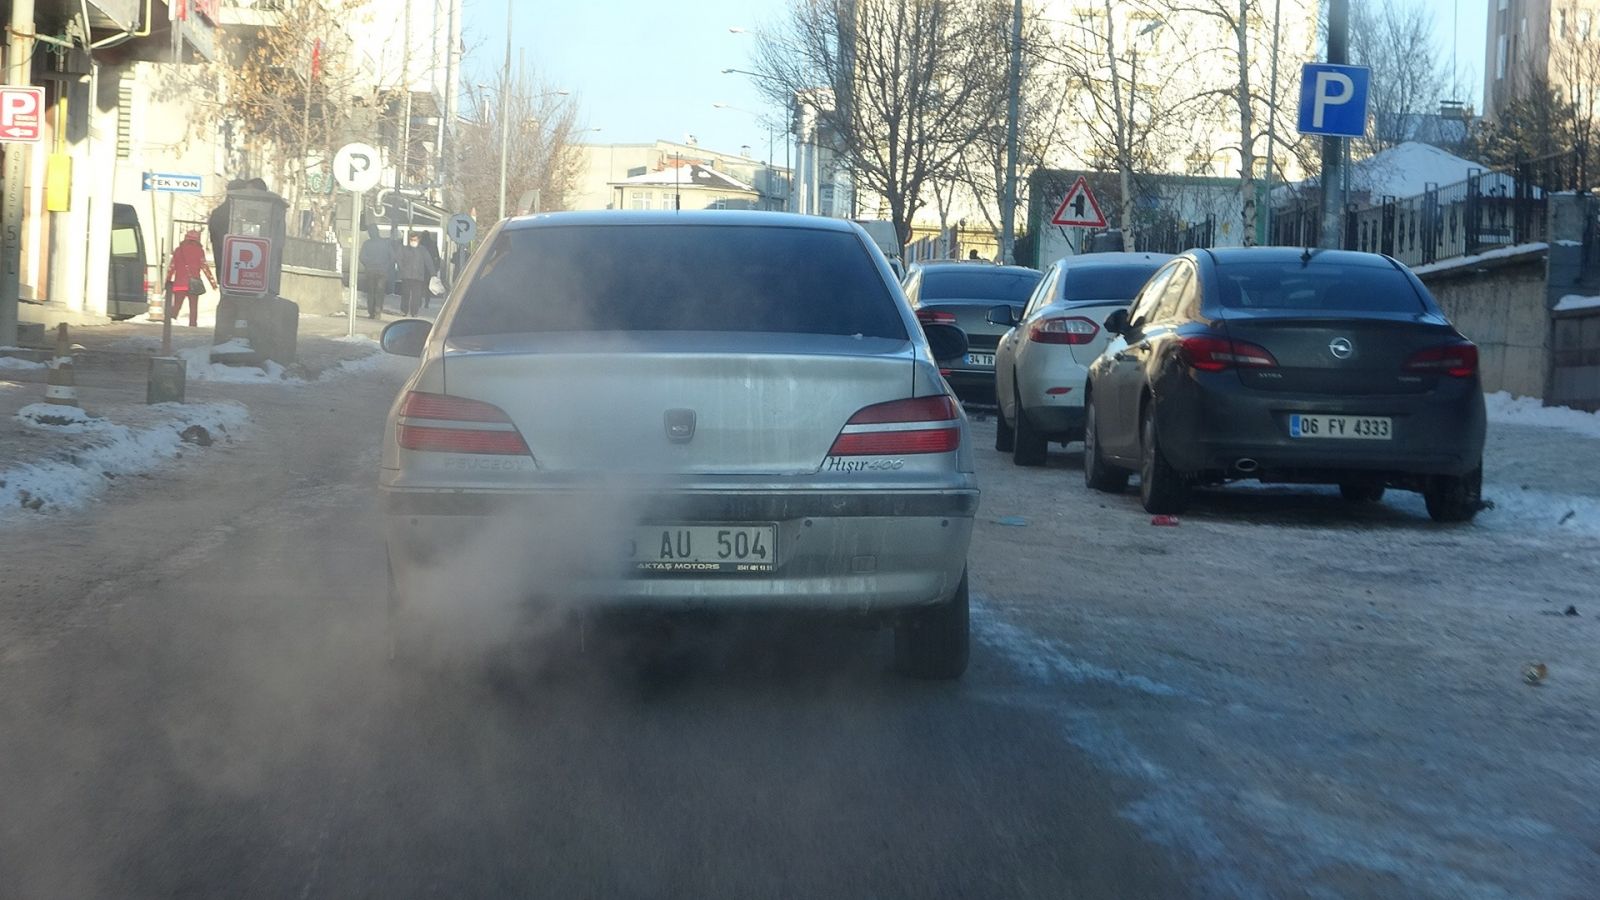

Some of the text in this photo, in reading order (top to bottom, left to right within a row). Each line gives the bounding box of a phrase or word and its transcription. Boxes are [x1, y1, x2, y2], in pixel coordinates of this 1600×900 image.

[2, 91, 37, 127] P
[1313, 71, 1354, 128] P
[349, 152, 371, 182] P
[230, 240, 262, 285] P
[969, 354, 980, 364] 34
[1301, 418, 1320, 434] 06
[1353, 419, 1388, 436] 4333
[660, 530, 691, 559] AU
[717, 530, 766, 560] 504
